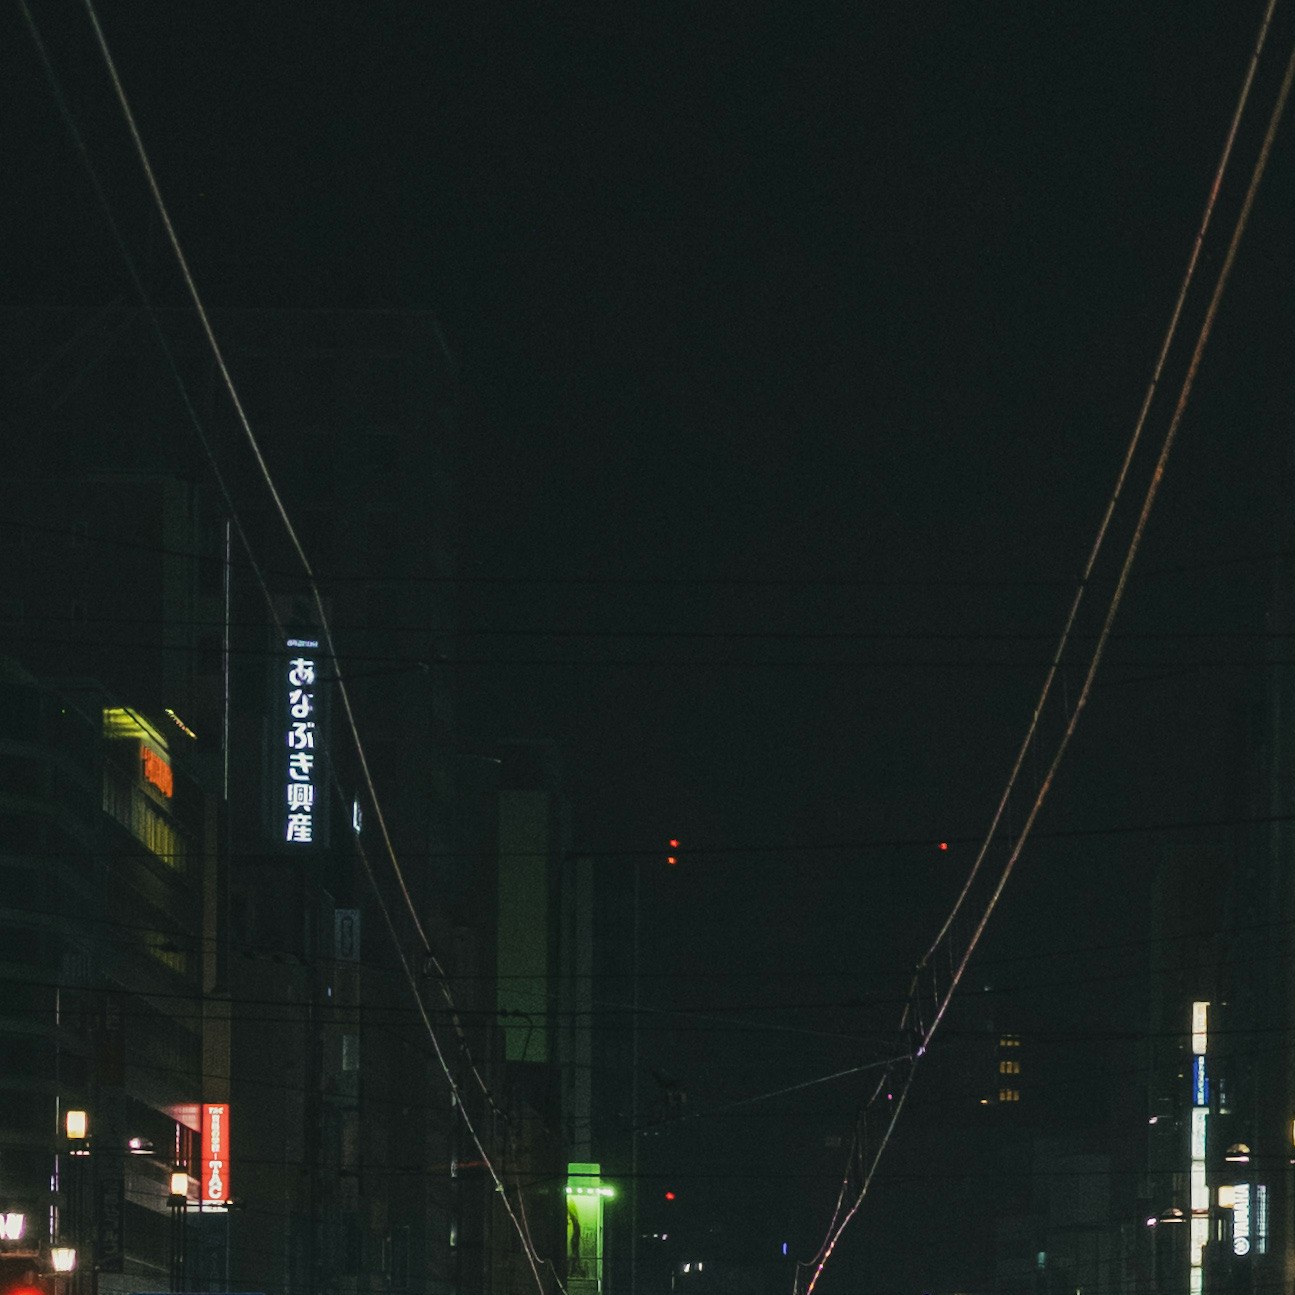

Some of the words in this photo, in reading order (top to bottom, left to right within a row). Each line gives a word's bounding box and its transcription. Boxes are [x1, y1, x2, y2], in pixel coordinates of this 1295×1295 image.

[286, 656, 316, 843] あなぶき興産
